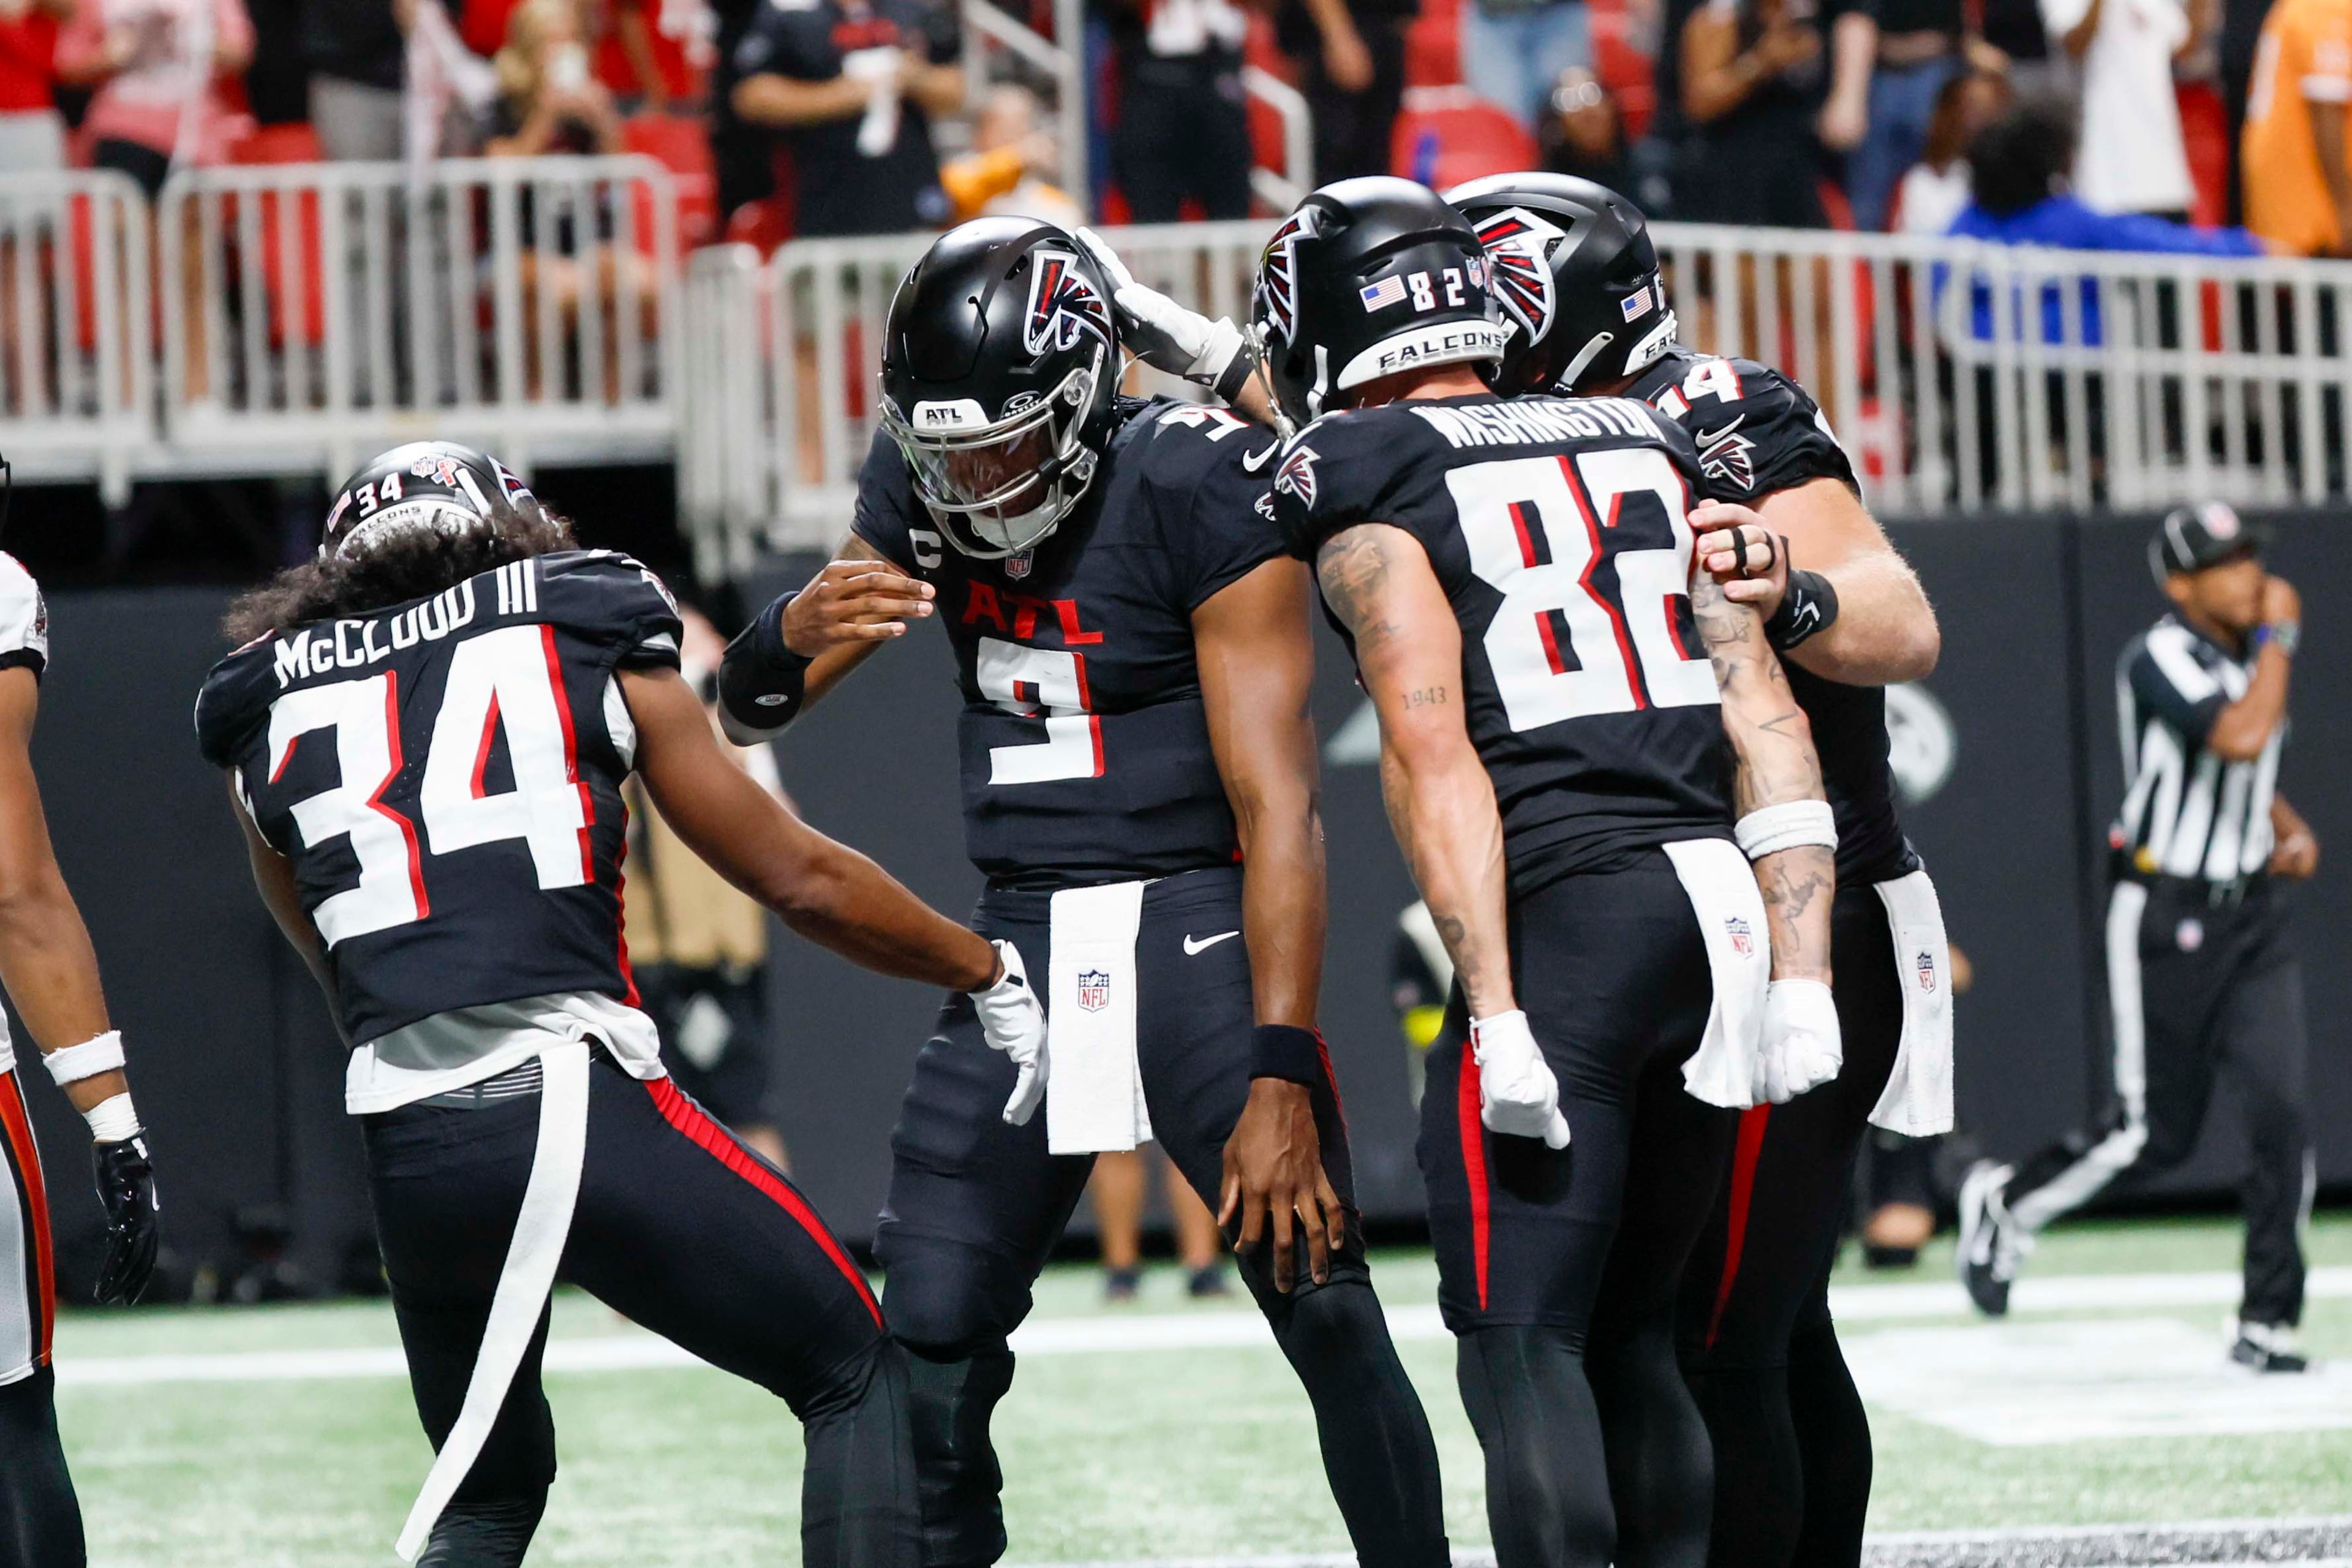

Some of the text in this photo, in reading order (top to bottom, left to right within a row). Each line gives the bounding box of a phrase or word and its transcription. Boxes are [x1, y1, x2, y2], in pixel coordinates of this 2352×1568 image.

[1408, 267, 1466, 312] 82
[1379, 331, 1502, 369] FALCONS
[1645, 331, 1676, 359] FAL
[925, 407, 963, 423] ATL
[355, 471, 405, 518] 34
[358, 506, 421, 537] ALCONS
[909, 528, 942, 569] C
[1010, 559, 1027, 573] NFL
[1444, 447, 1722, 733] 82
[273, 559, 537, 689] McCLOUD III
[961, 578, 1103, 645] ATL
[976, 636, 1106, 785] 9
[1401, 685, 1448, 710] 1943
[267, 624, 595, 952] 34
[1732, 935, 1752, 954] NFL
[1081, 988, 1106, 1008] NFL
[1918, 970, 1934, 990] NFL
